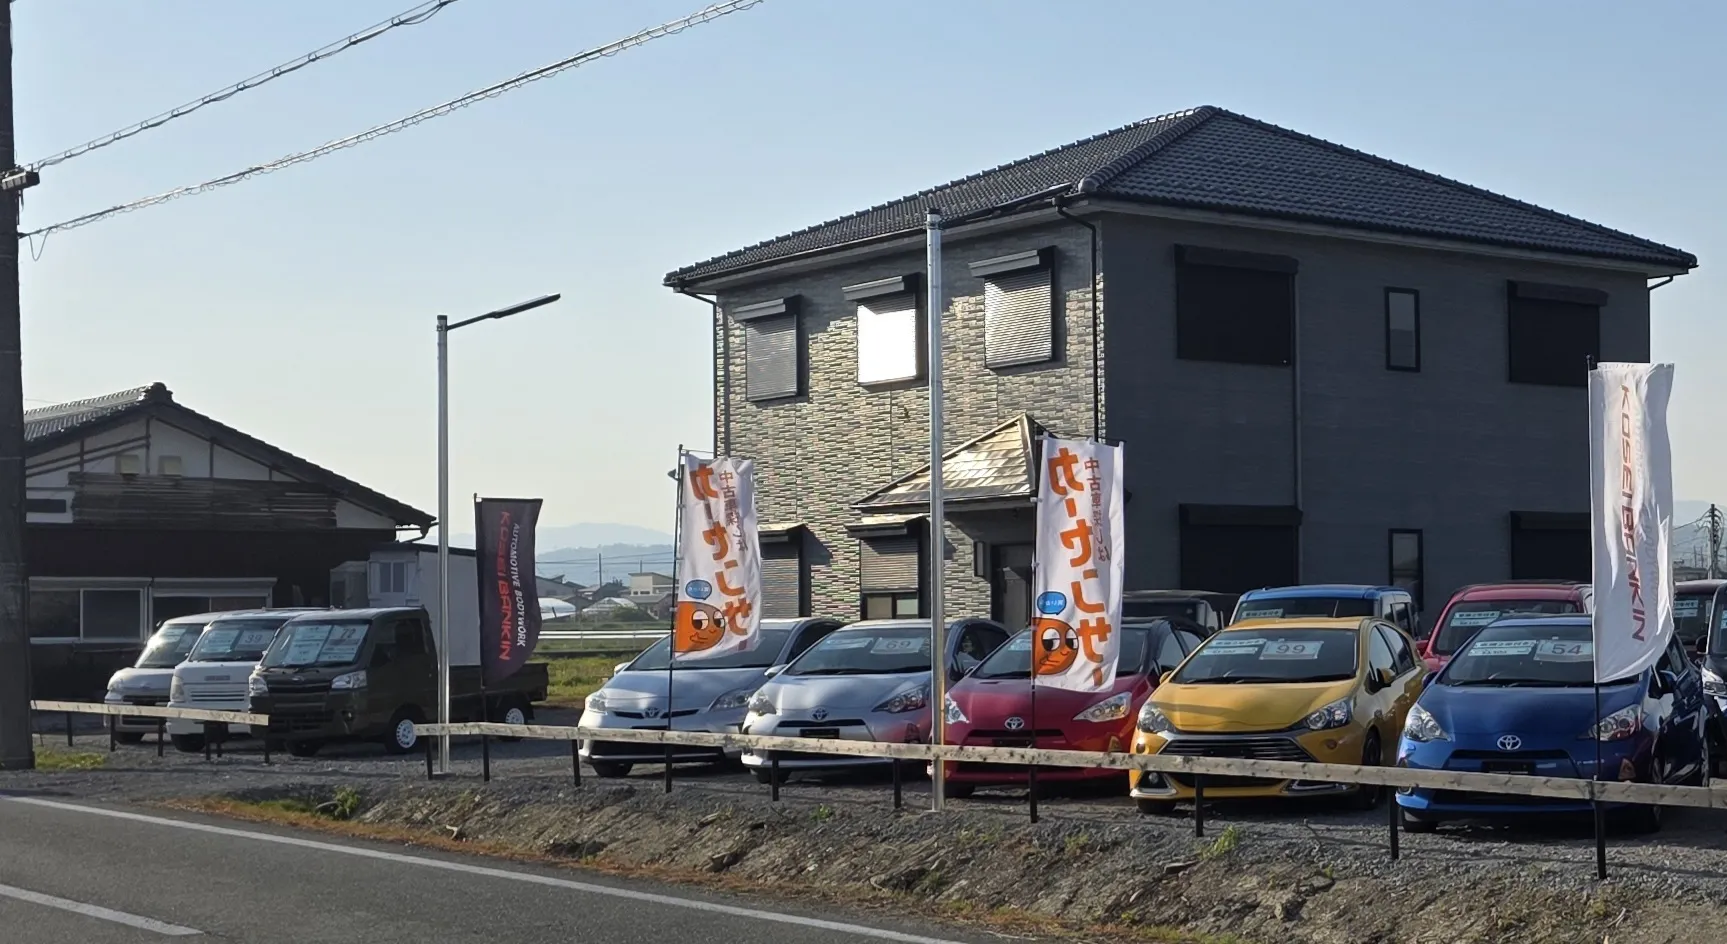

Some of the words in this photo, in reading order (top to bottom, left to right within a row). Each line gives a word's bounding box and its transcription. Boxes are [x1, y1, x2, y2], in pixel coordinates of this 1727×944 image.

[1620, 385, 1633, 497] KOSEI
[509, 523, 520, 587] AUTOMOTIVE
[1620, 506, 1646, 642] BANKIN
[498, 579, 512, 661] BANKIN
[514, 588, 526, 647] BODYWORK
[1276, 644, 1305, 653] 99
[1551, 643, 1583, 655] 54
